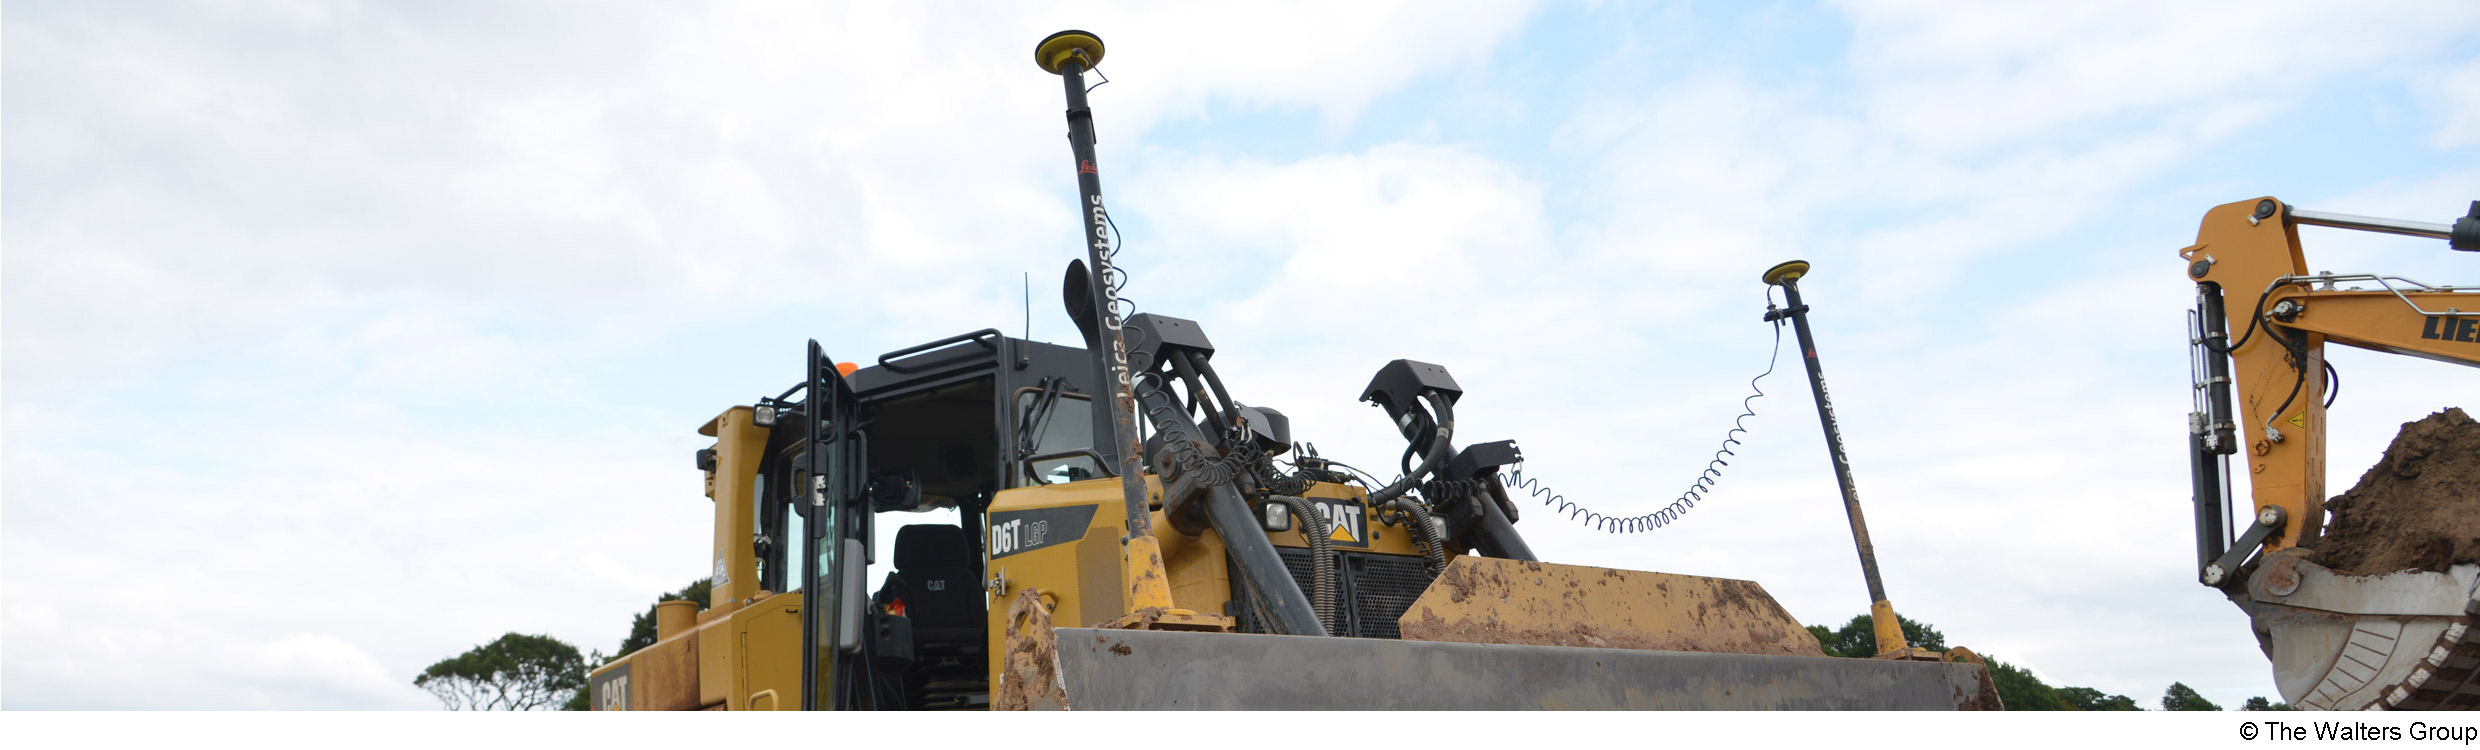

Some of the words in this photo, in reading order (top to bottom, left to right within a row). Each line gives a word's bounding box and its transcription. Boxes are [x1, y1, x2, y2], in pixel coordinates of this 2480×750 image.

[1090, 195, 1122, 330] Geosystems
[2421, 316, 2480, 343] LIE
[991, 518, 1021, 556] D6T
[1024, 520, 1048, 548] LGP
[1315, 502, 1360, 543] CAT
[927, 579, 946, 591] CAT
[602, 675, 627, 710] CAT
